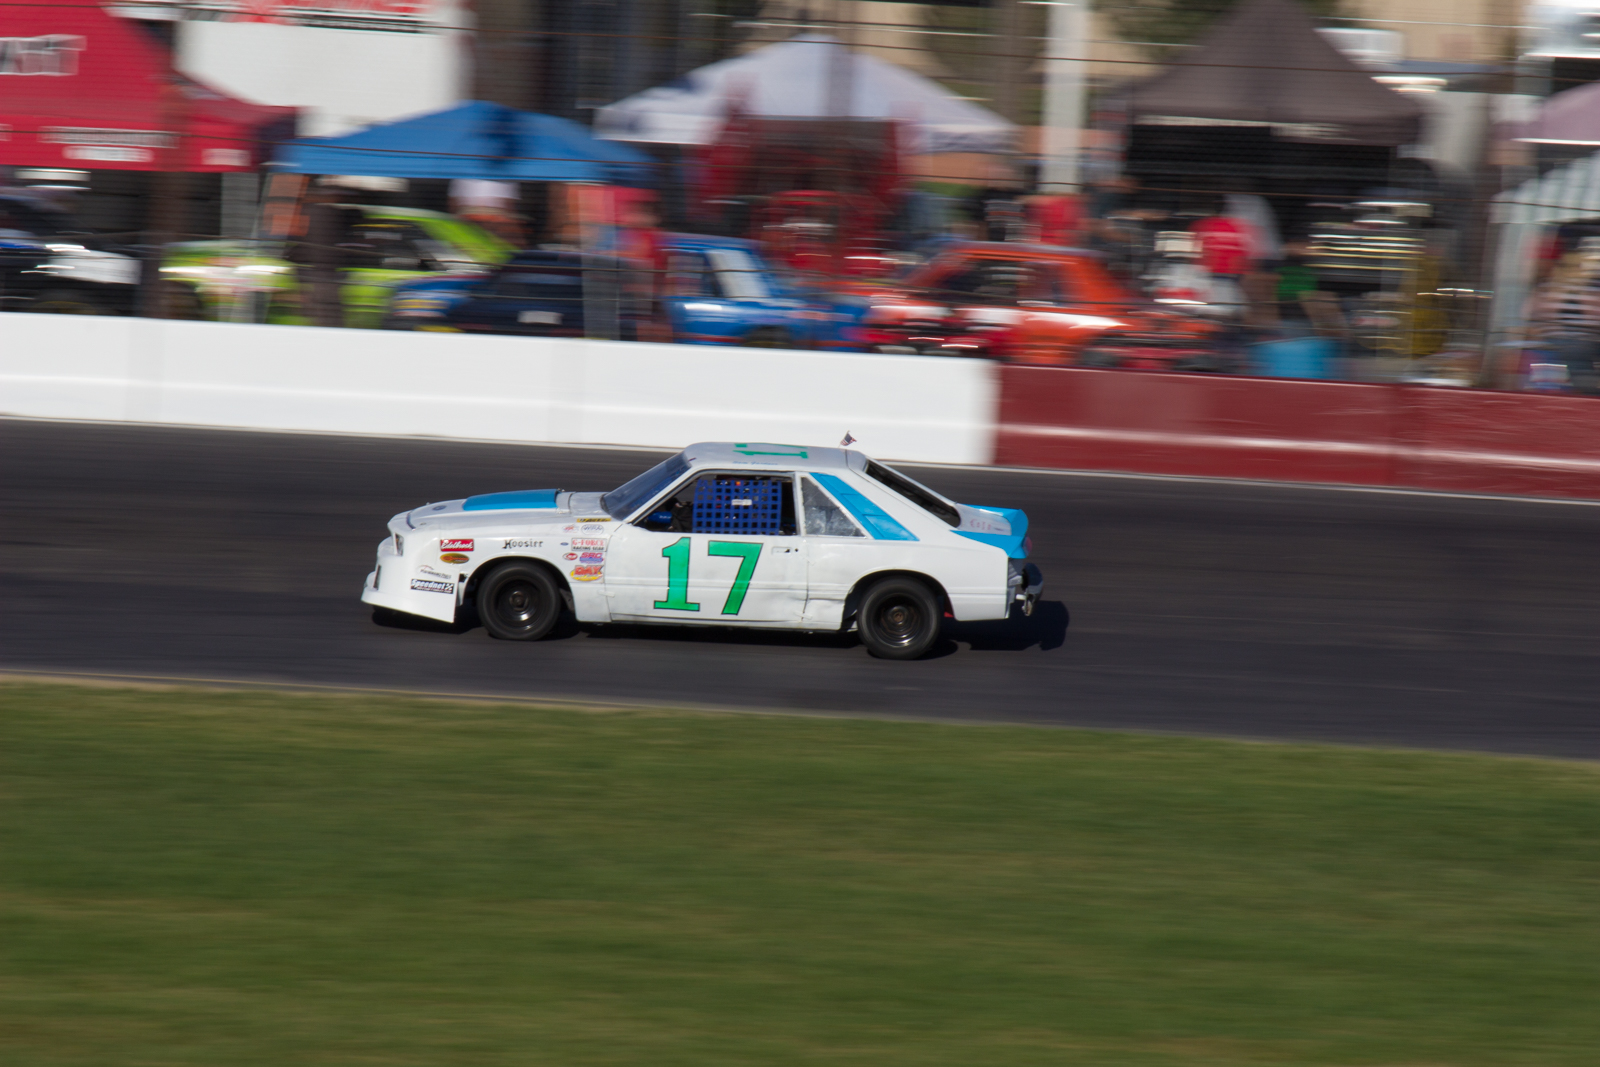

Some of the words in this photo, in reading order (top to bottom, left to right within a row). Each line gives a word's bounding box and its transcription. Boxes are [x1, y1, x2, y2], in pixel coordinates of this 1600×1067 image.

[441, 540, 473, 549] Edelbrock
[502, 538, 543, 549] Hoosier
[653, 536, 764, 616] 17
